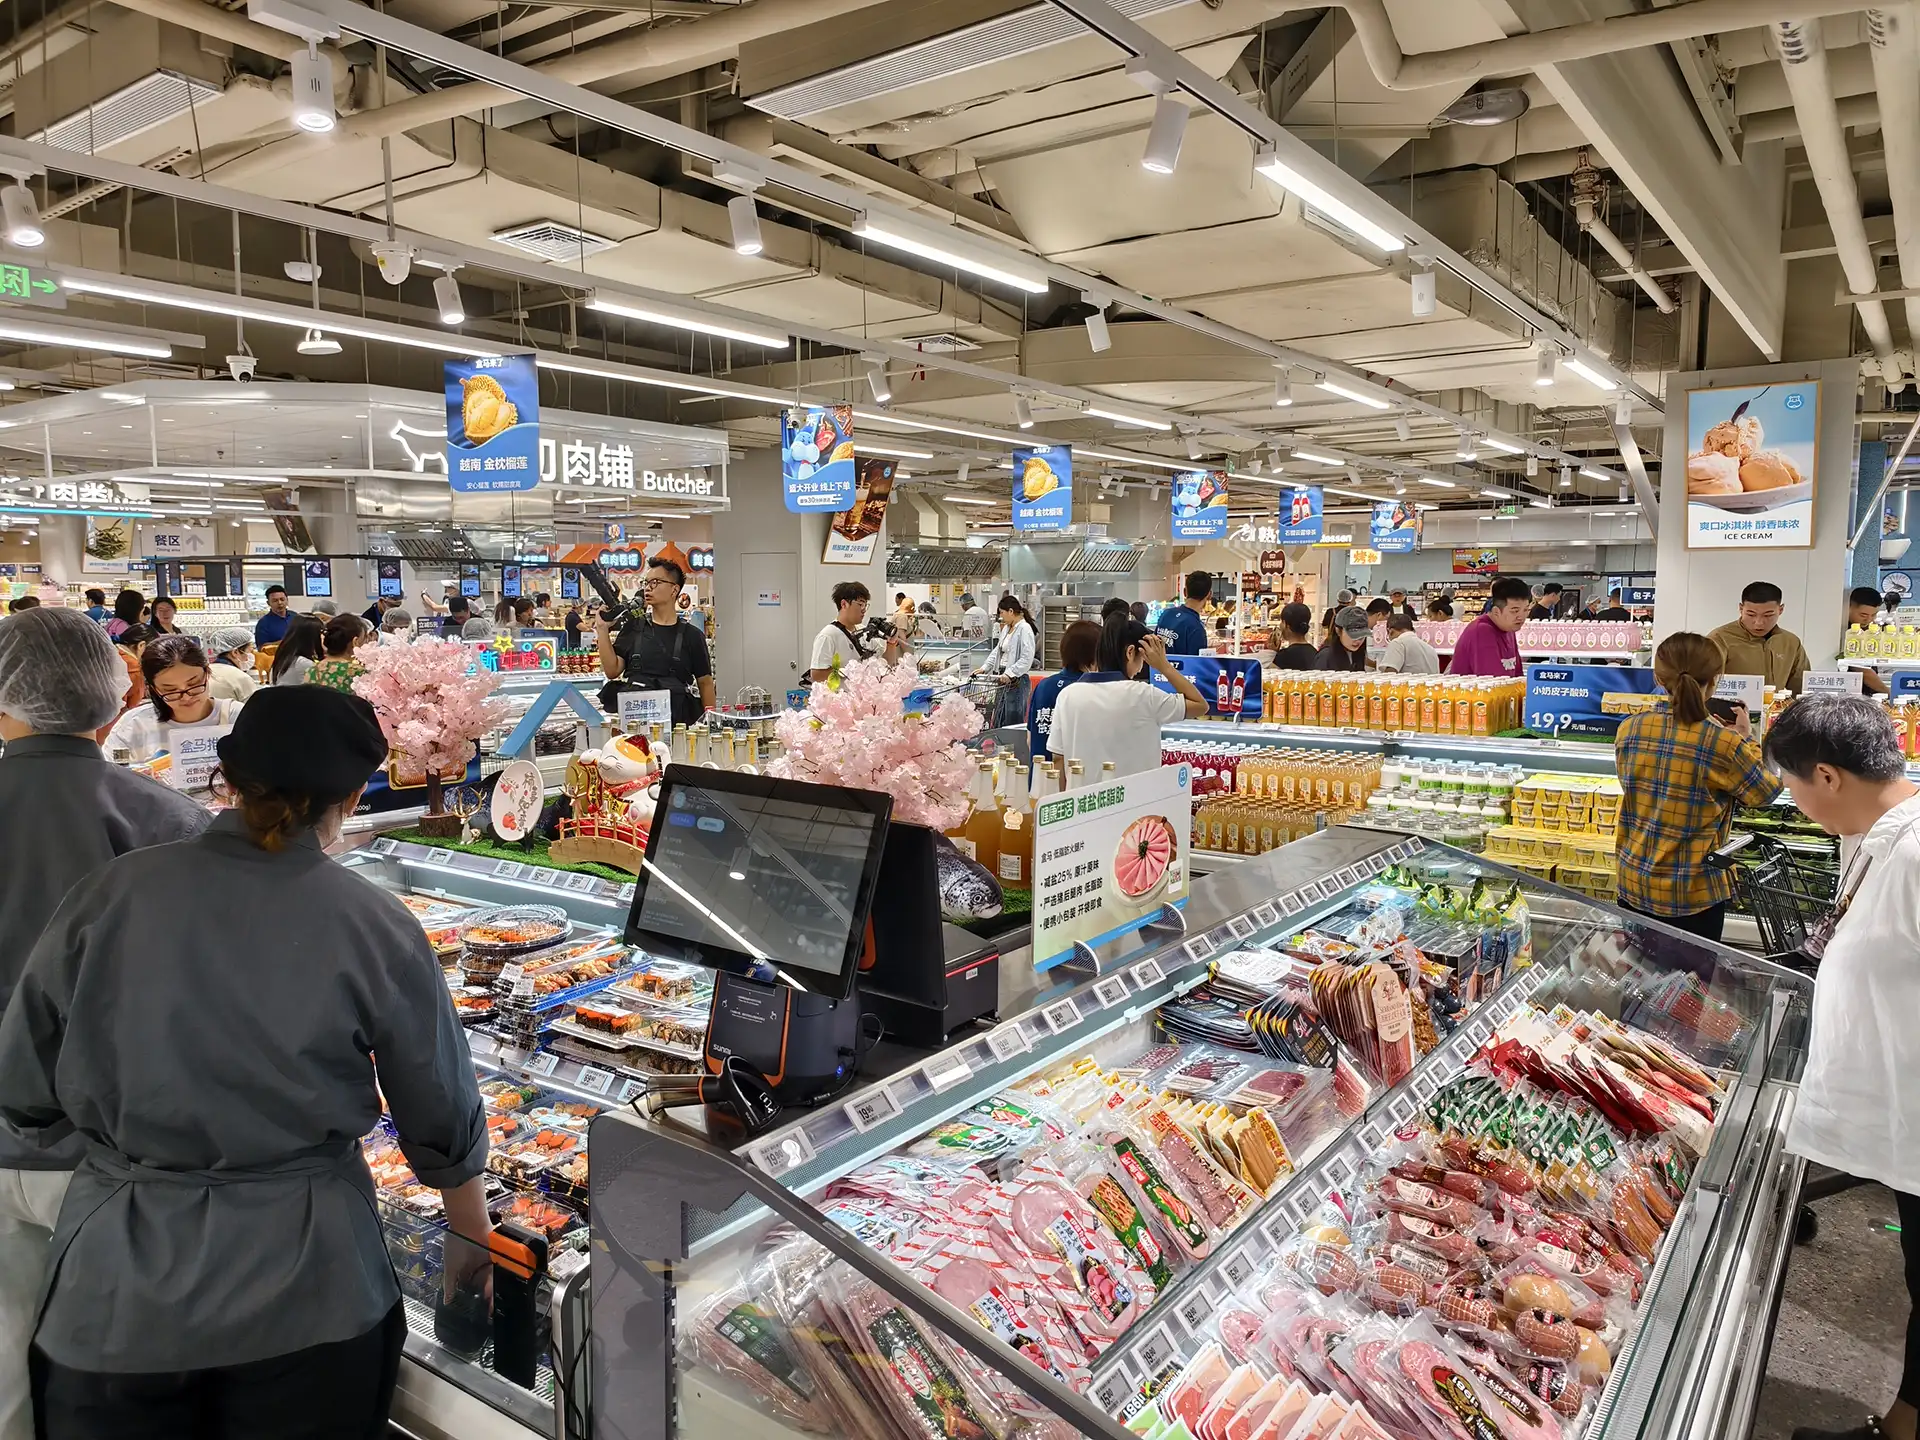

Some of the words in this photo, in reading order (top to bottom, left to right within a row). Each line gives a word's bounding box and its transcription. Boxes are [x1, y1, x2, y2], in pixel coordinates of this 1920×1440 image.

[475, 358, 504, 369] 盒马来了
[459, 458, 481, 471] 越南
[483, 456, 528, 471] 金枕榴莲
[643, 469, 714, 496] Butcher
[788, 482, 819, 493] 盛大开业
[820, 481, 851, 492] 线上下单
[1699, 520, 1752, 531] 爽口冰淇淋
[1755, 519, 1800, 530] 醇香味浓
[155, 534, 181, 547] 餐区
[1740, 532, 1773, 540] CREAM
[1539, 671, 1568, 680] 盒马来了
[1807, 676, 1845, 686] 盒马推荐
[1532, 686, 1589, 698] 小奶皮子酸奶
[624, 699, 657, 712] 盒马推荐
[1077, 785, 1125, 815] 减盐低脂肪
[1074, 859, 1100, 881] 原汁原味
[1043, 907, 1076, 930] 便携小包装
[1077, 896, 1103, 916] 开袋即食
